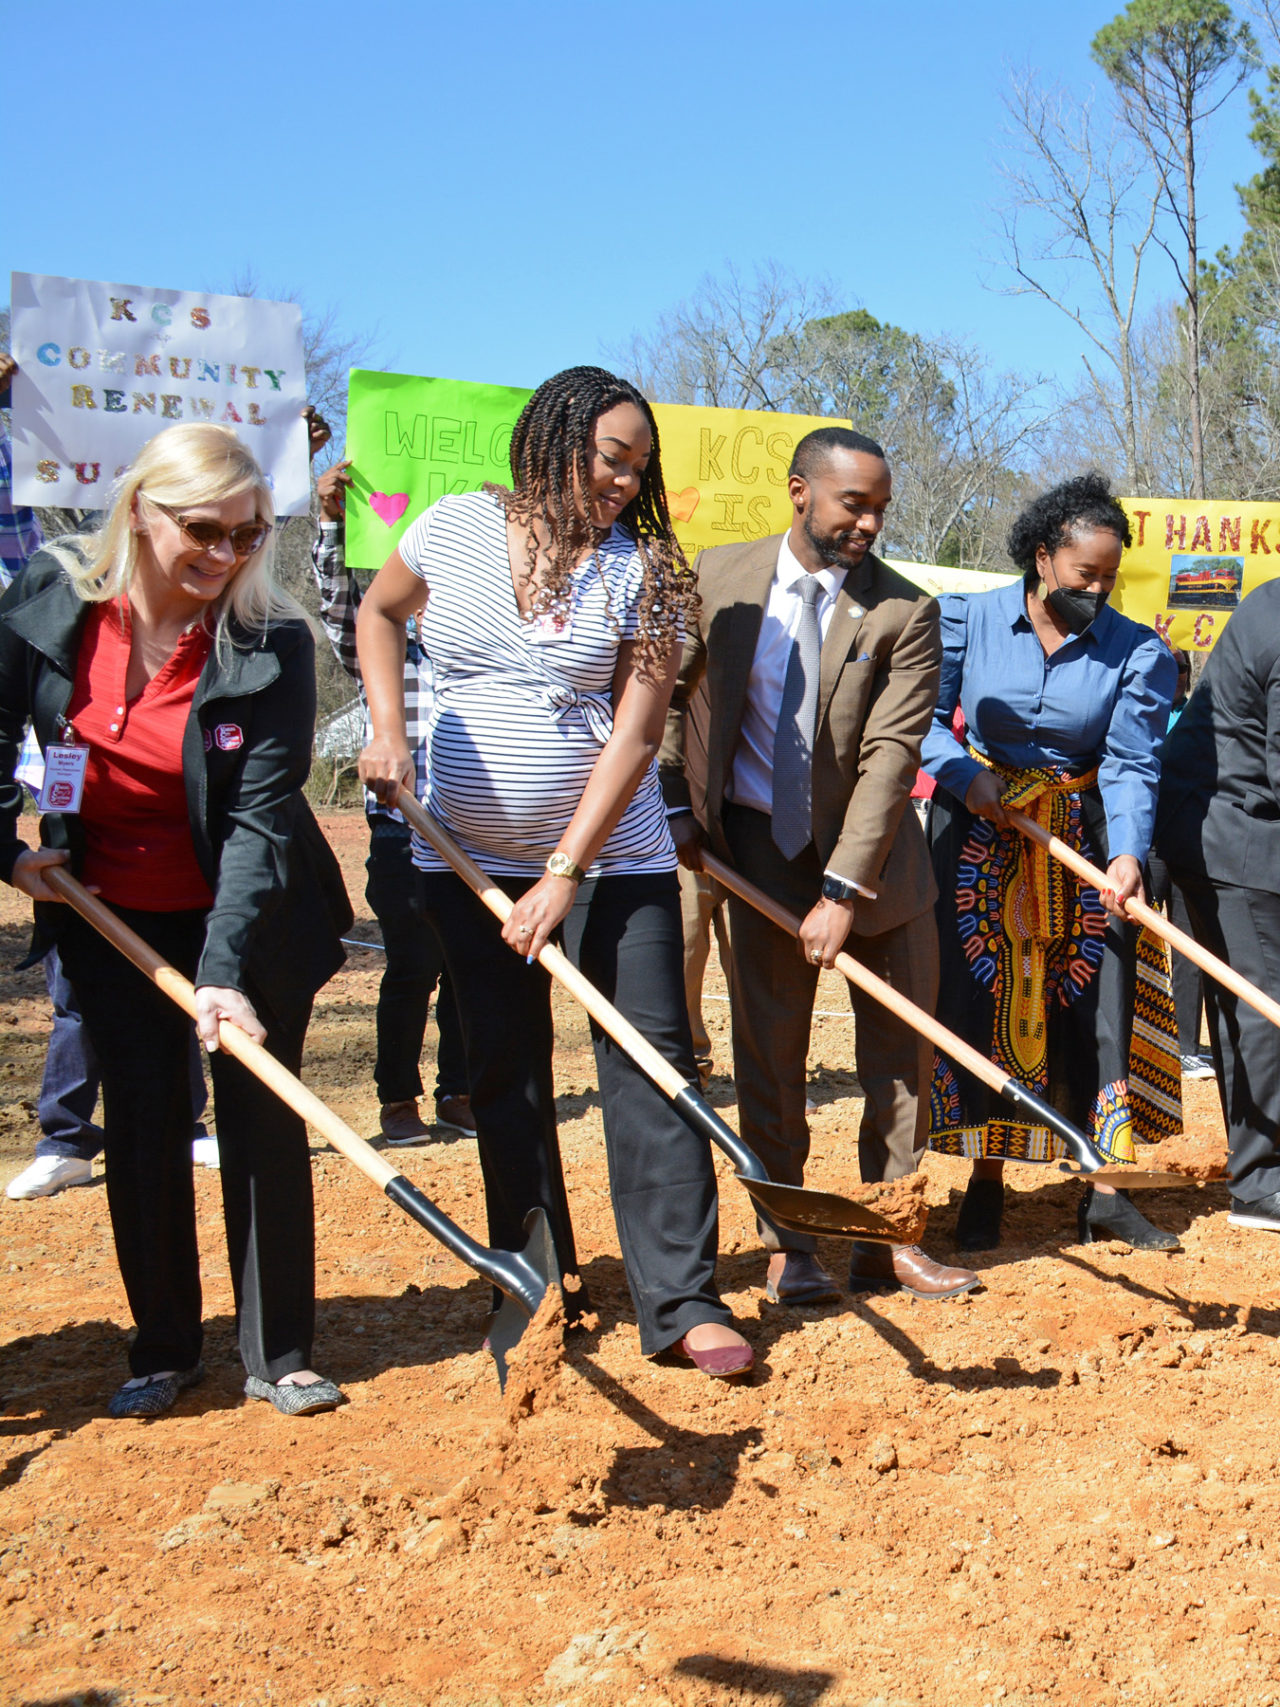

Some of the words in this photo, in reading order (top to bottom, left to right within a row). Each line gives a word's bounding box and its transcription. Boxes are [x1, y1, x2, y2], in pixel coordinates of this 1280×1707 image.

[110, 298, 212, 330] KCS
[36, 342, 286, 391] COMMUNITY
[71, 384, 266, 426] RENEWAL
[698, 426, 794, 487] KCS
[711, 493, 772, 542] IS
[53, 751, 82, 760] Lesley
